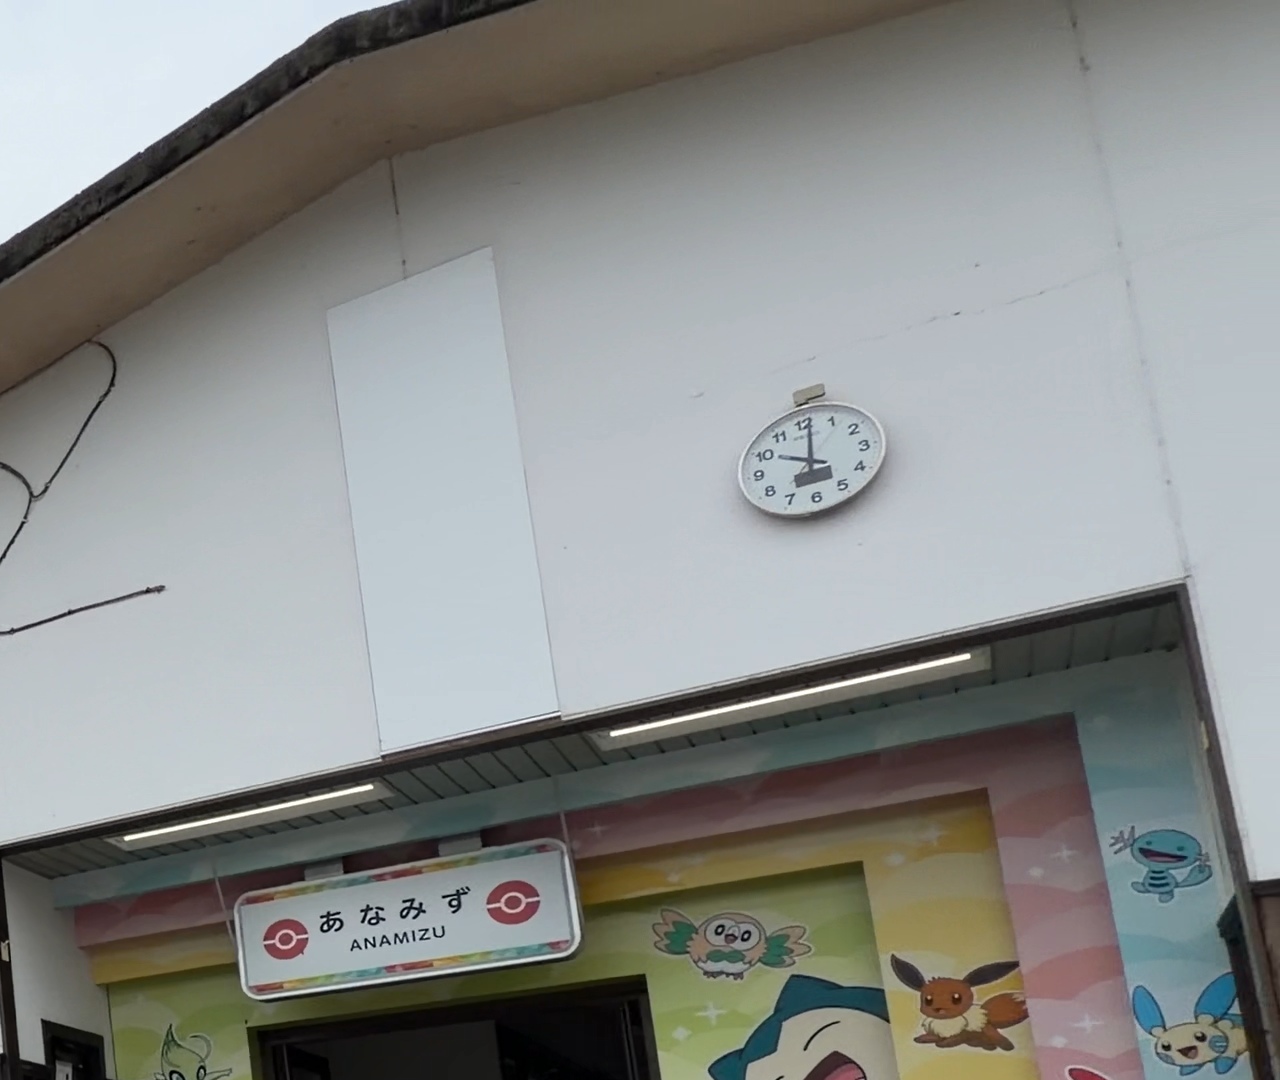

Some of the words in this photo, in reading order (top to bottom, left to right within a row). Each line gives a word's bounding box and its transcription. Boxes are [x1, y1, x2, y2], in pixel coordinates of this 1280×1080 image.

[794, 416, 813, 431] 12
[827, 416, 836, 427] 1
[848, 423, 860, 435] 2
[772, 430, 787, 443] 11
[858, 440, 871, 451] 3
[755, 449, 774, 463] 10
[853, 461, 867, 472] 4
[753, 470, 765, 481] 9
[764, 485, 776, 497] 8
[837, 479, 849, 491] 5
[784, 493, 796, 505] 7
[810, 491, 823, 503] 6
[319, 885, 472, 935] あなみず
[349, 925, 447, 952] ANAMIZU
